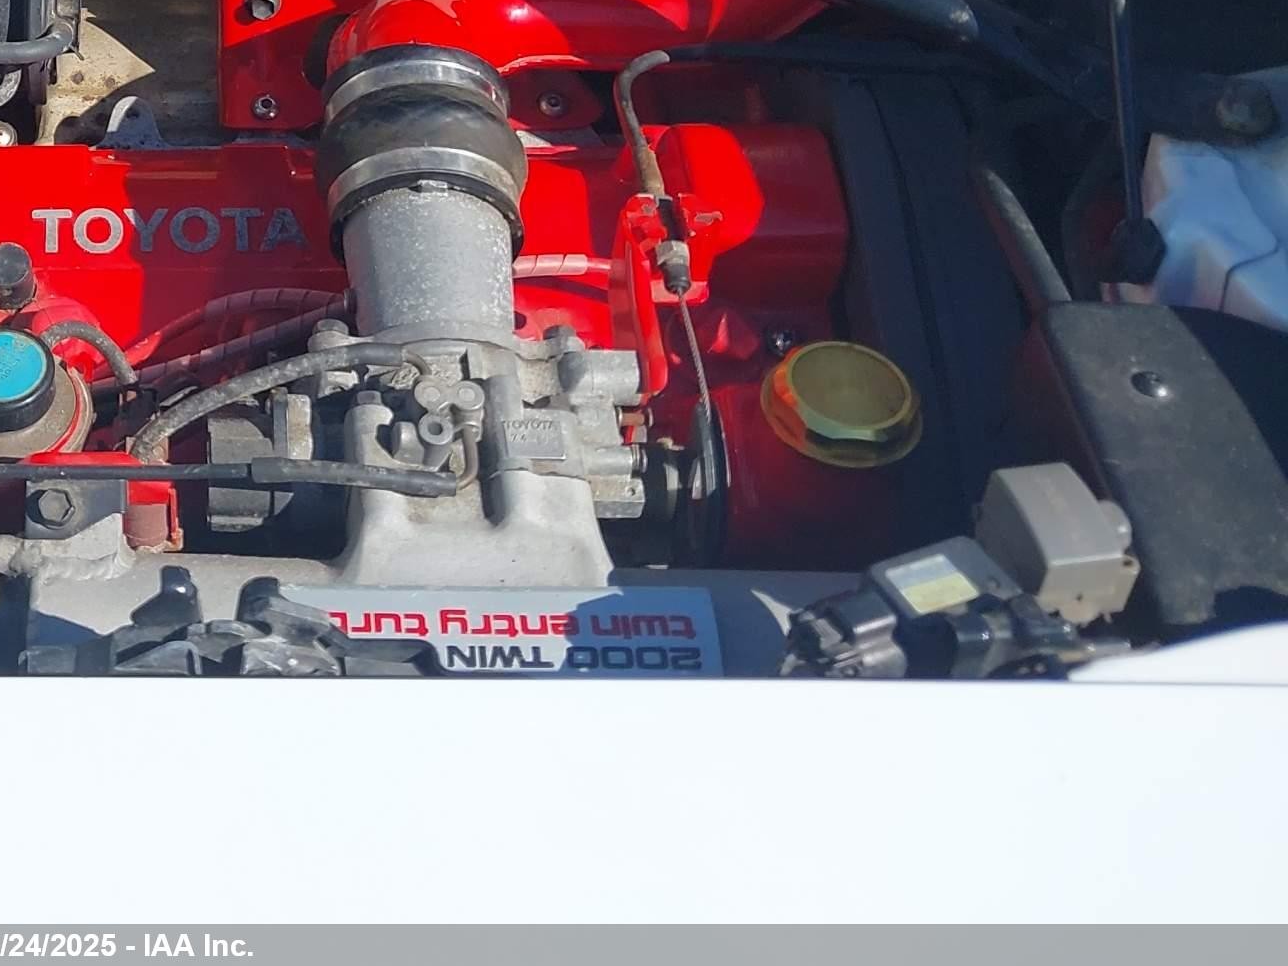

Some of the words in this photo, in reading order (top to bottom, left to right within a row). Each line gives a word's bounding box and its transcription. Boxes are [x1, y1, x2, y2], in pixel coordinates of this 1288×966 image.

[31, 207, 309, 254] TOYOTA
[440, 609, 579, 638] entry
[591, 614, 696, 640] twin
[447, 645, 555, 669] TWIN
[566, 646, 703, 671] 2000
